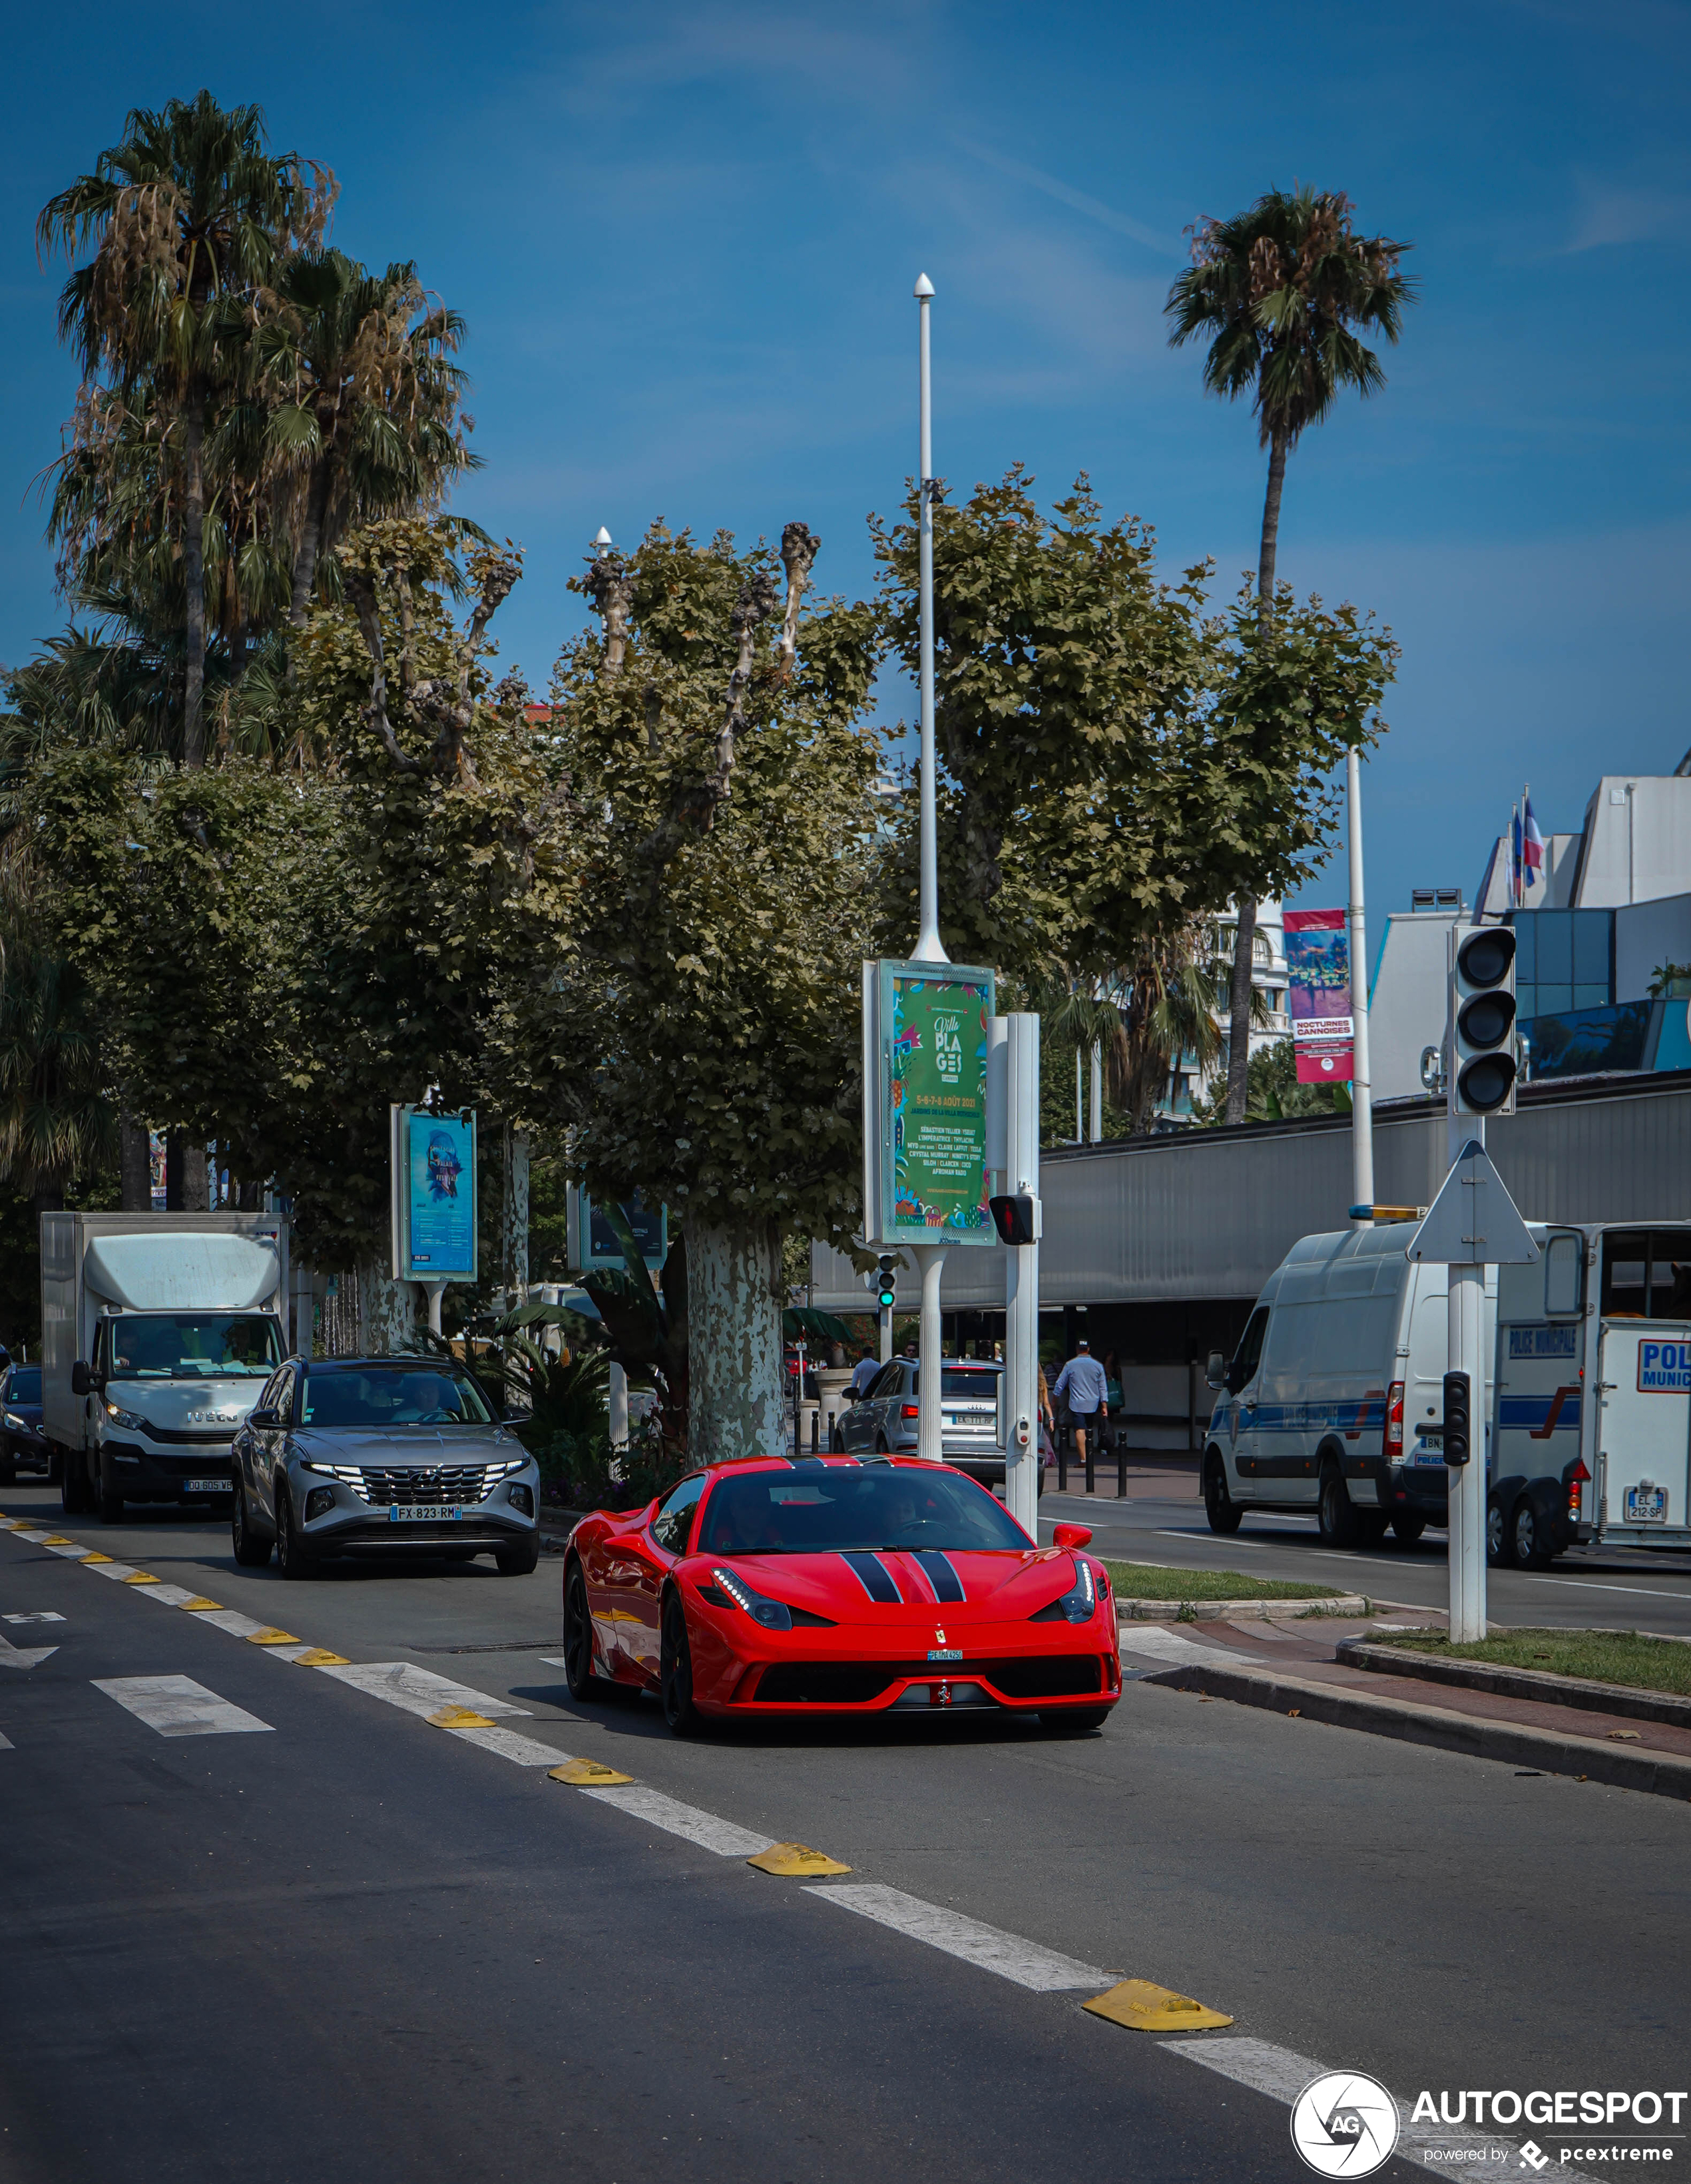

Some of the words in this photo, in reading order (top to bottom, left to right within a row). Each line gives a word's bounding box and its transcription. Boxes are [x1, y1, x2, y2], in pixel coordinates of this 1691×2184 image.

[934, 1016, 960, 1033] Villa
[1297, 1020, 1349, 1028] NOCTURNES
[1298, 1027, 1350, 1036] CANNOISES
[935, 1032, 961, 1052] PLA
[936, 1052, 962, 1073] GES
[943, 1096, 961, 1107] AOÛT
[962, 1097, 975, 1108] 2021
[188, 1412, 238, 1422] IVECO
[399, 1507, 455, 1519] FX-823-RM
[1632, 1506, 1662, 1517] 212-SP
